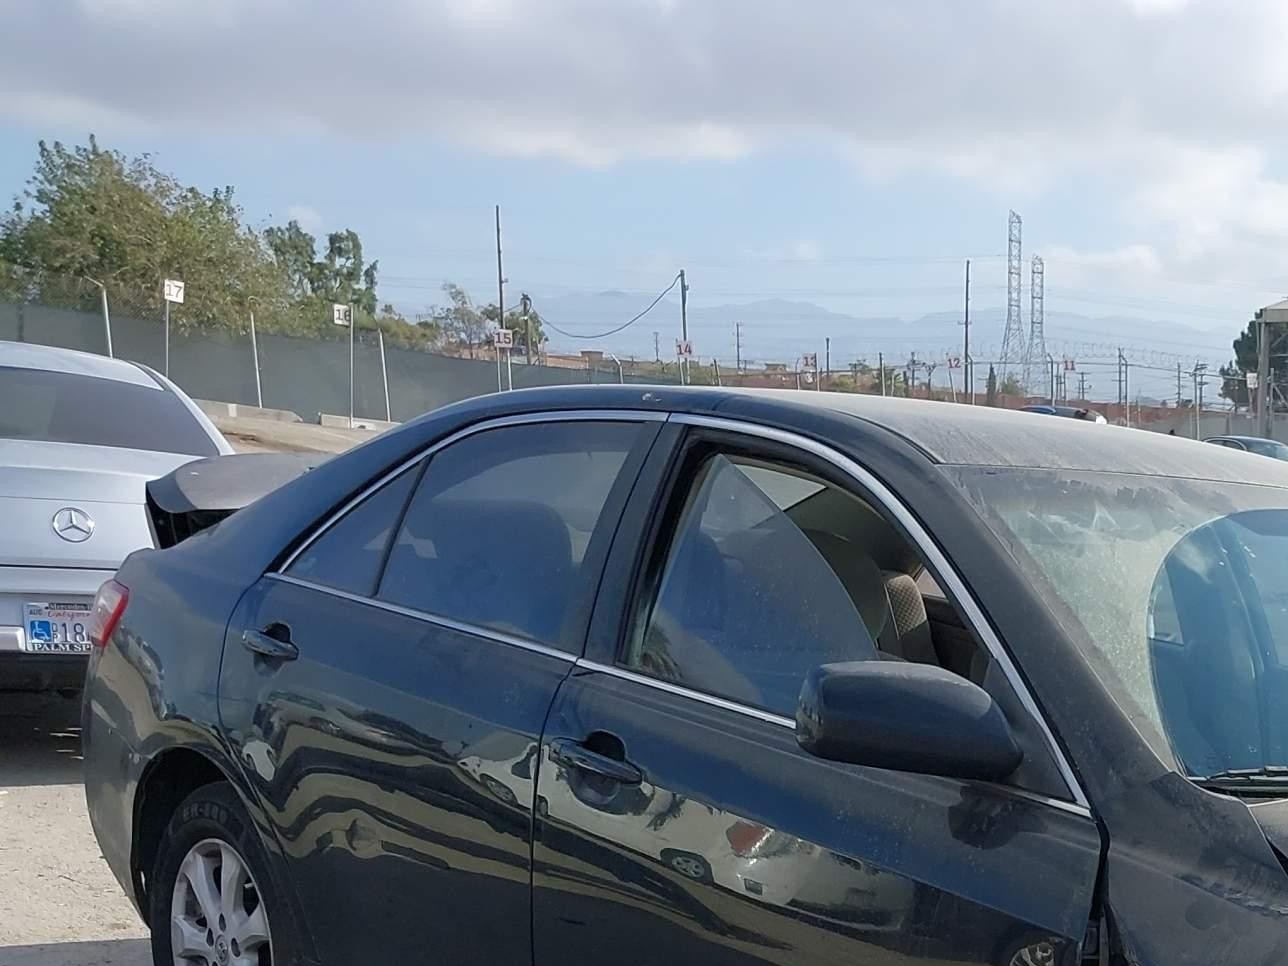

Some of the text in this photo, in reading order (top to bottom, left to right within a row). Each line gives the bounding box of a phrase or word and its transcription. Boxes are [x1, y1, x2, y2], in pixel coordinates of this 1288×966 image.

[166, 284, 182, 298] 17
[495, 332, 511, 344] 15
[676, 344, 691, 355] 14
[948, 358, 961, 368] 12
[1064, 361, 1075, 370] 11
[61, 622, 90, 642] 18
[33, 643, 70, 652] PALM
